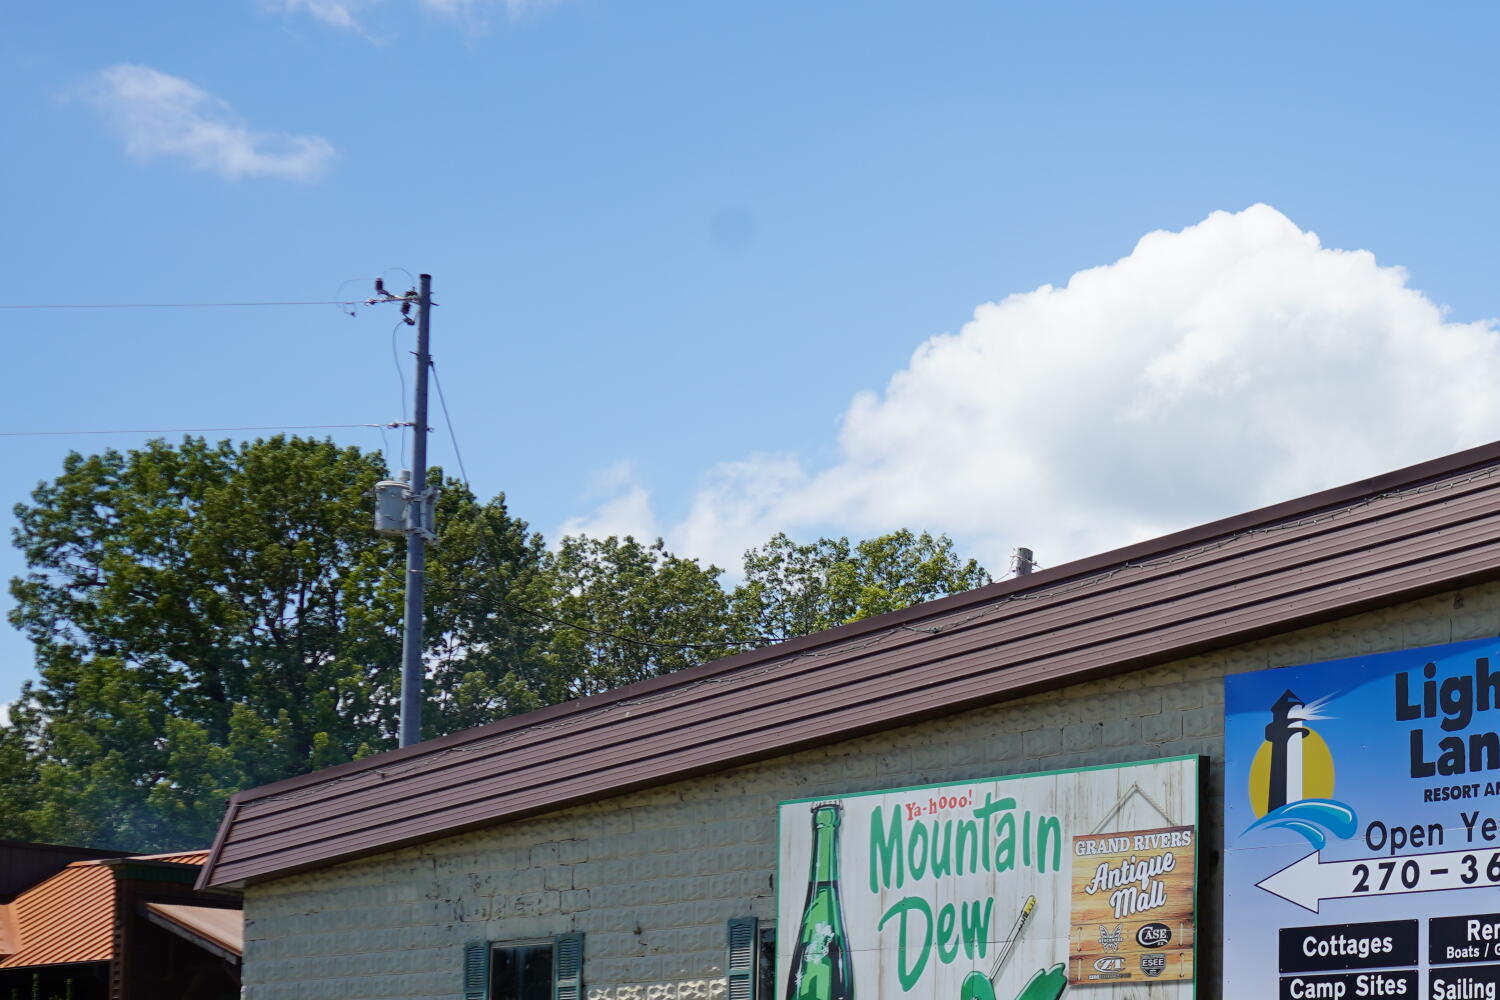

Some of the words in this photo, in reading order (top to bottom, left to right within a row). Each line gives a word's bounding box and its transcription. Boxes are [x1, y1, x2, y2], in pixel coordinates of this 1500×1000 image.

[905, 789, 973, 821] Ya-hooo!
[1424, 783, 1480, 802] RESORT
[869, 792, 1061, 894] Mountain
[1075, 837, 1131, 856] GRAND
[1133, 830, 1192, 851] RIVERS
[1365, 820, 1444, 855] Open
[1085, 852, 1176, 894] Antique
[1109, 880, 1167, 919] Mall
[878, 896, 994, 992] Dew
[1138, 926, 1168, 946] CASE
[1303, 934, 1393, 958] Cottages
[1142, 958, 1165, 968] ESEE
[1446, 946, 1480, 959] Boats
[1484, 943, 1490, 958] /
[1290, 978, 1346, 1000] Camp
[1355, 974, 1407, 996] Sites
